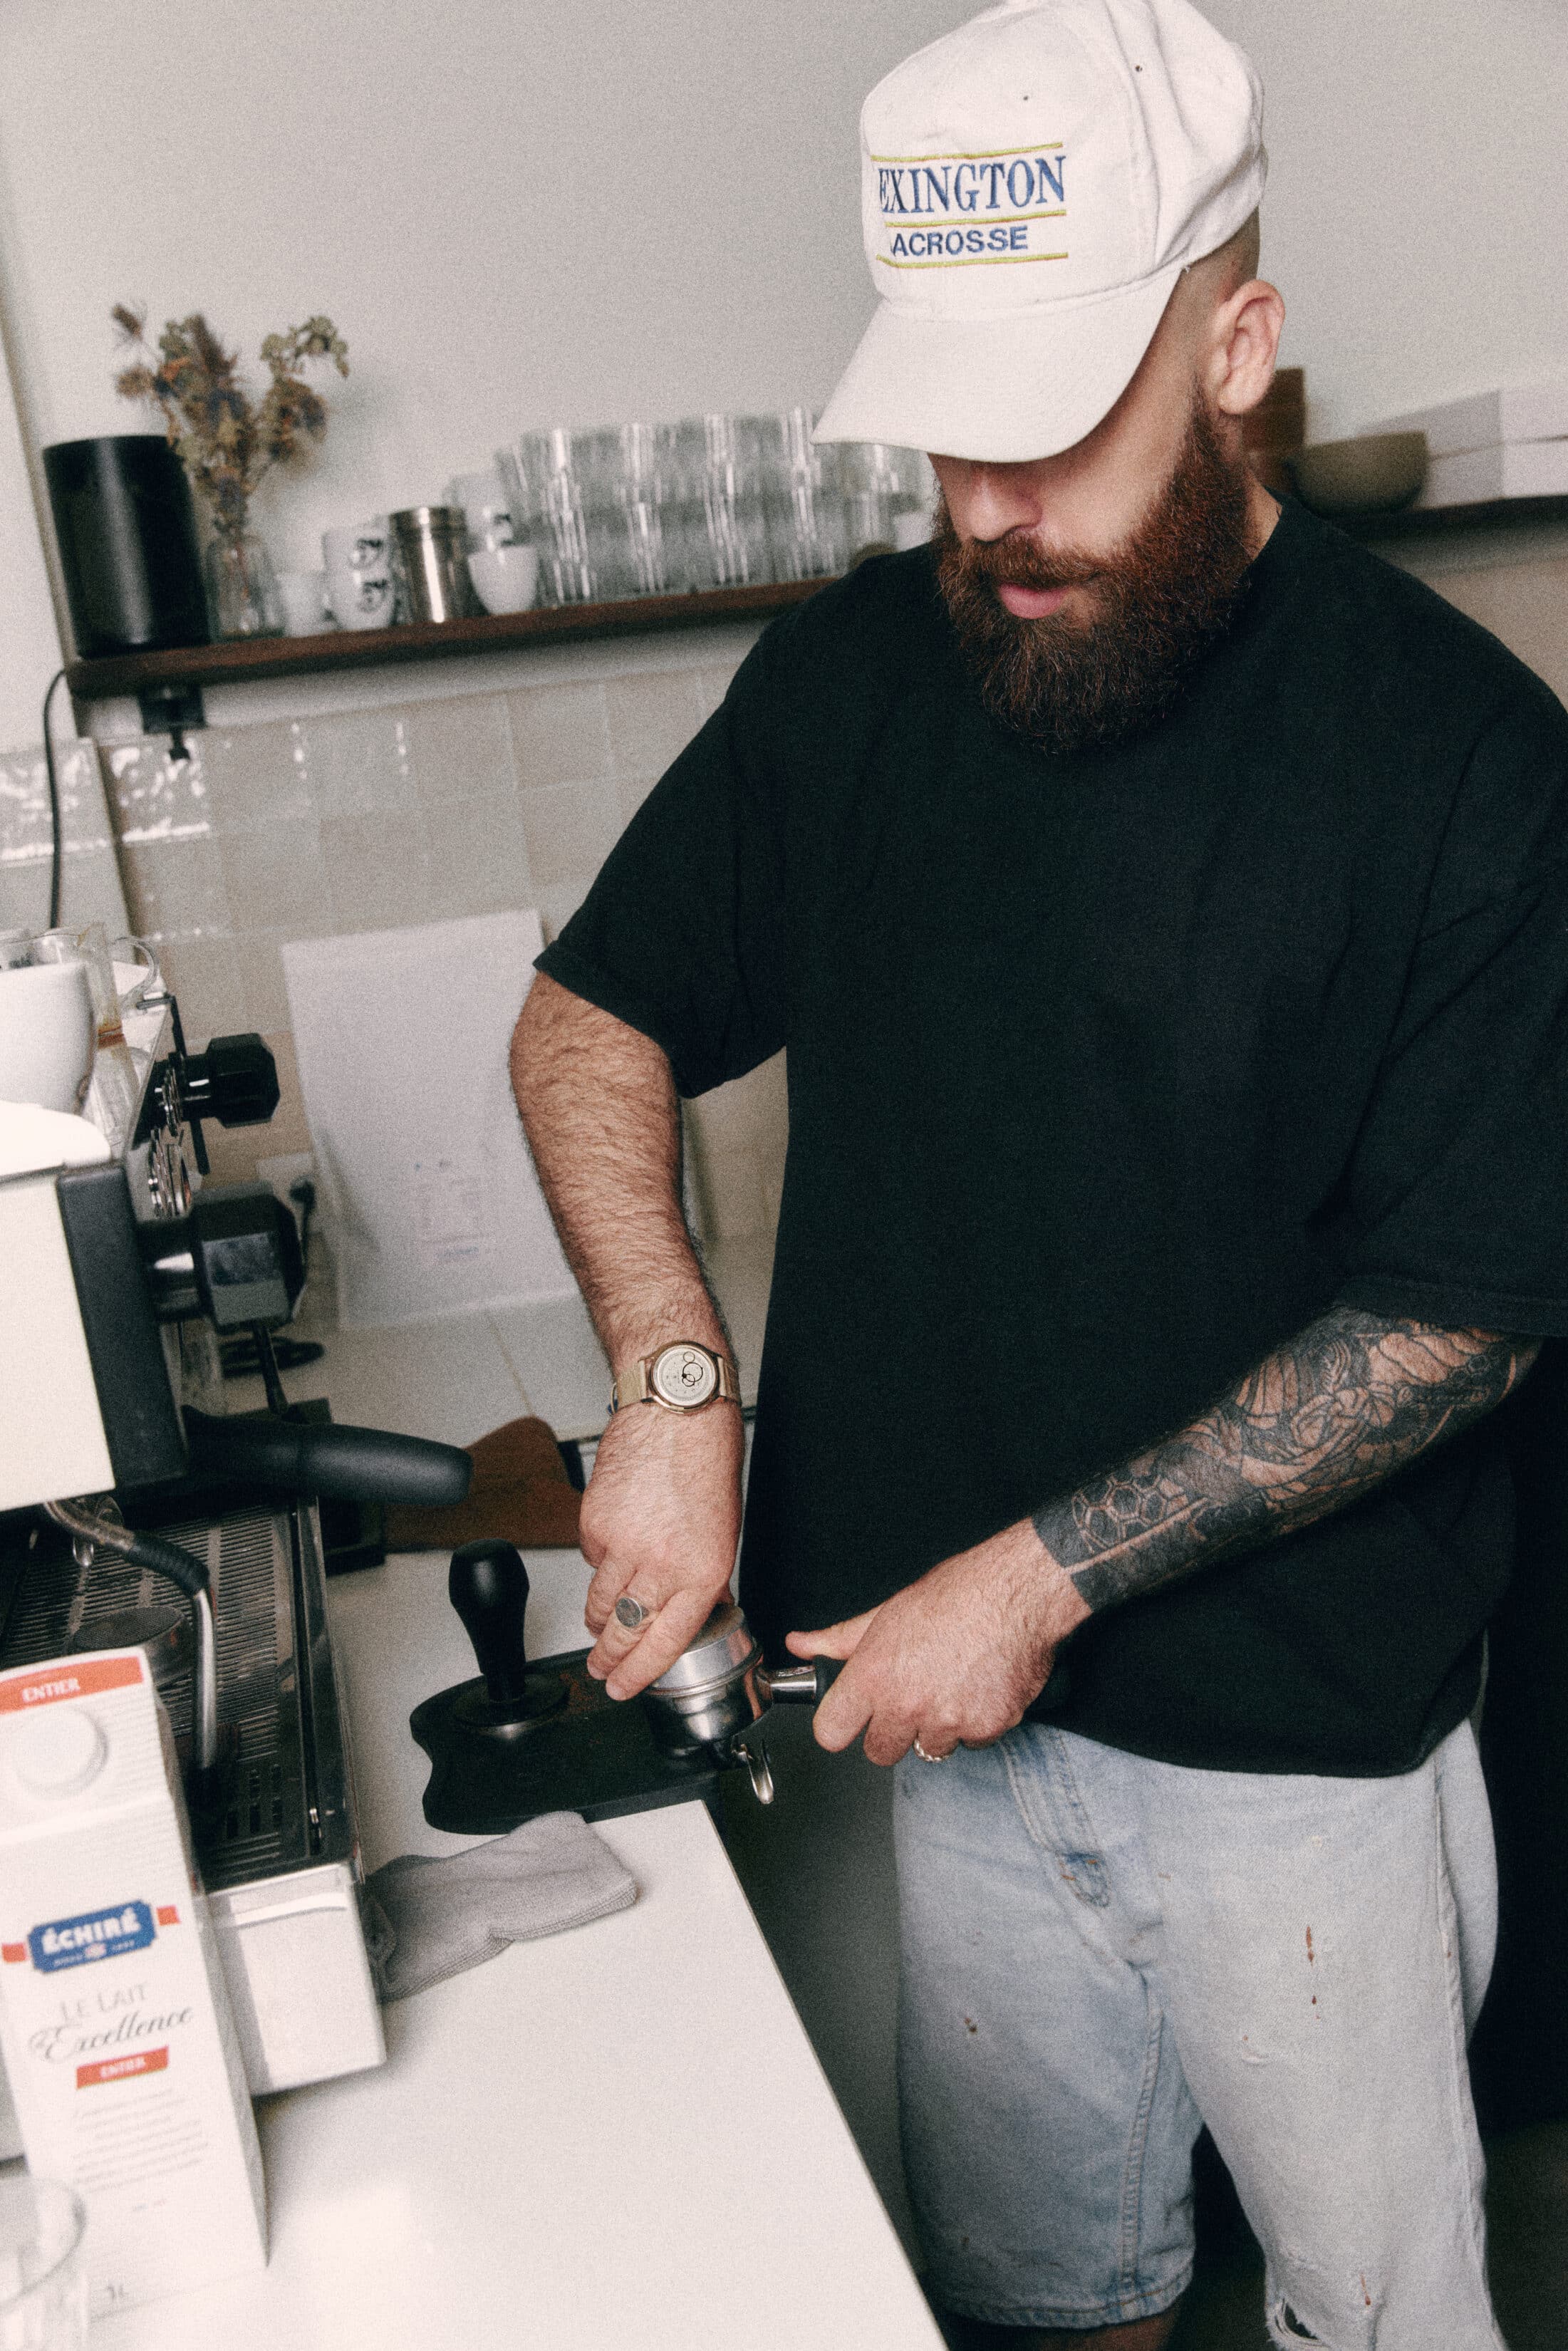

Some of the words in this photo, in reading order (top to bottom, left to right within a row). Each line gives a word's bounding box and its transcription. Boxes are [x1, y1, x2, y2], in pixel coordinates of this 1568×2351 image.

[878, 155, 1066, 214] EXINGTON
[890, 225, 1029, 257] ACROSSE
[22, 1678, 81, 1703] ENTIER
[41, 1906, 141, 1956] ÉCHIRÉ
[61, 1998, 90, 2020] LE
[98, 1983, 149, 2012] LAIT
[28, 2006, 194, 2063] Excellence
[100, 2056, 147, 2080] ENTIER
